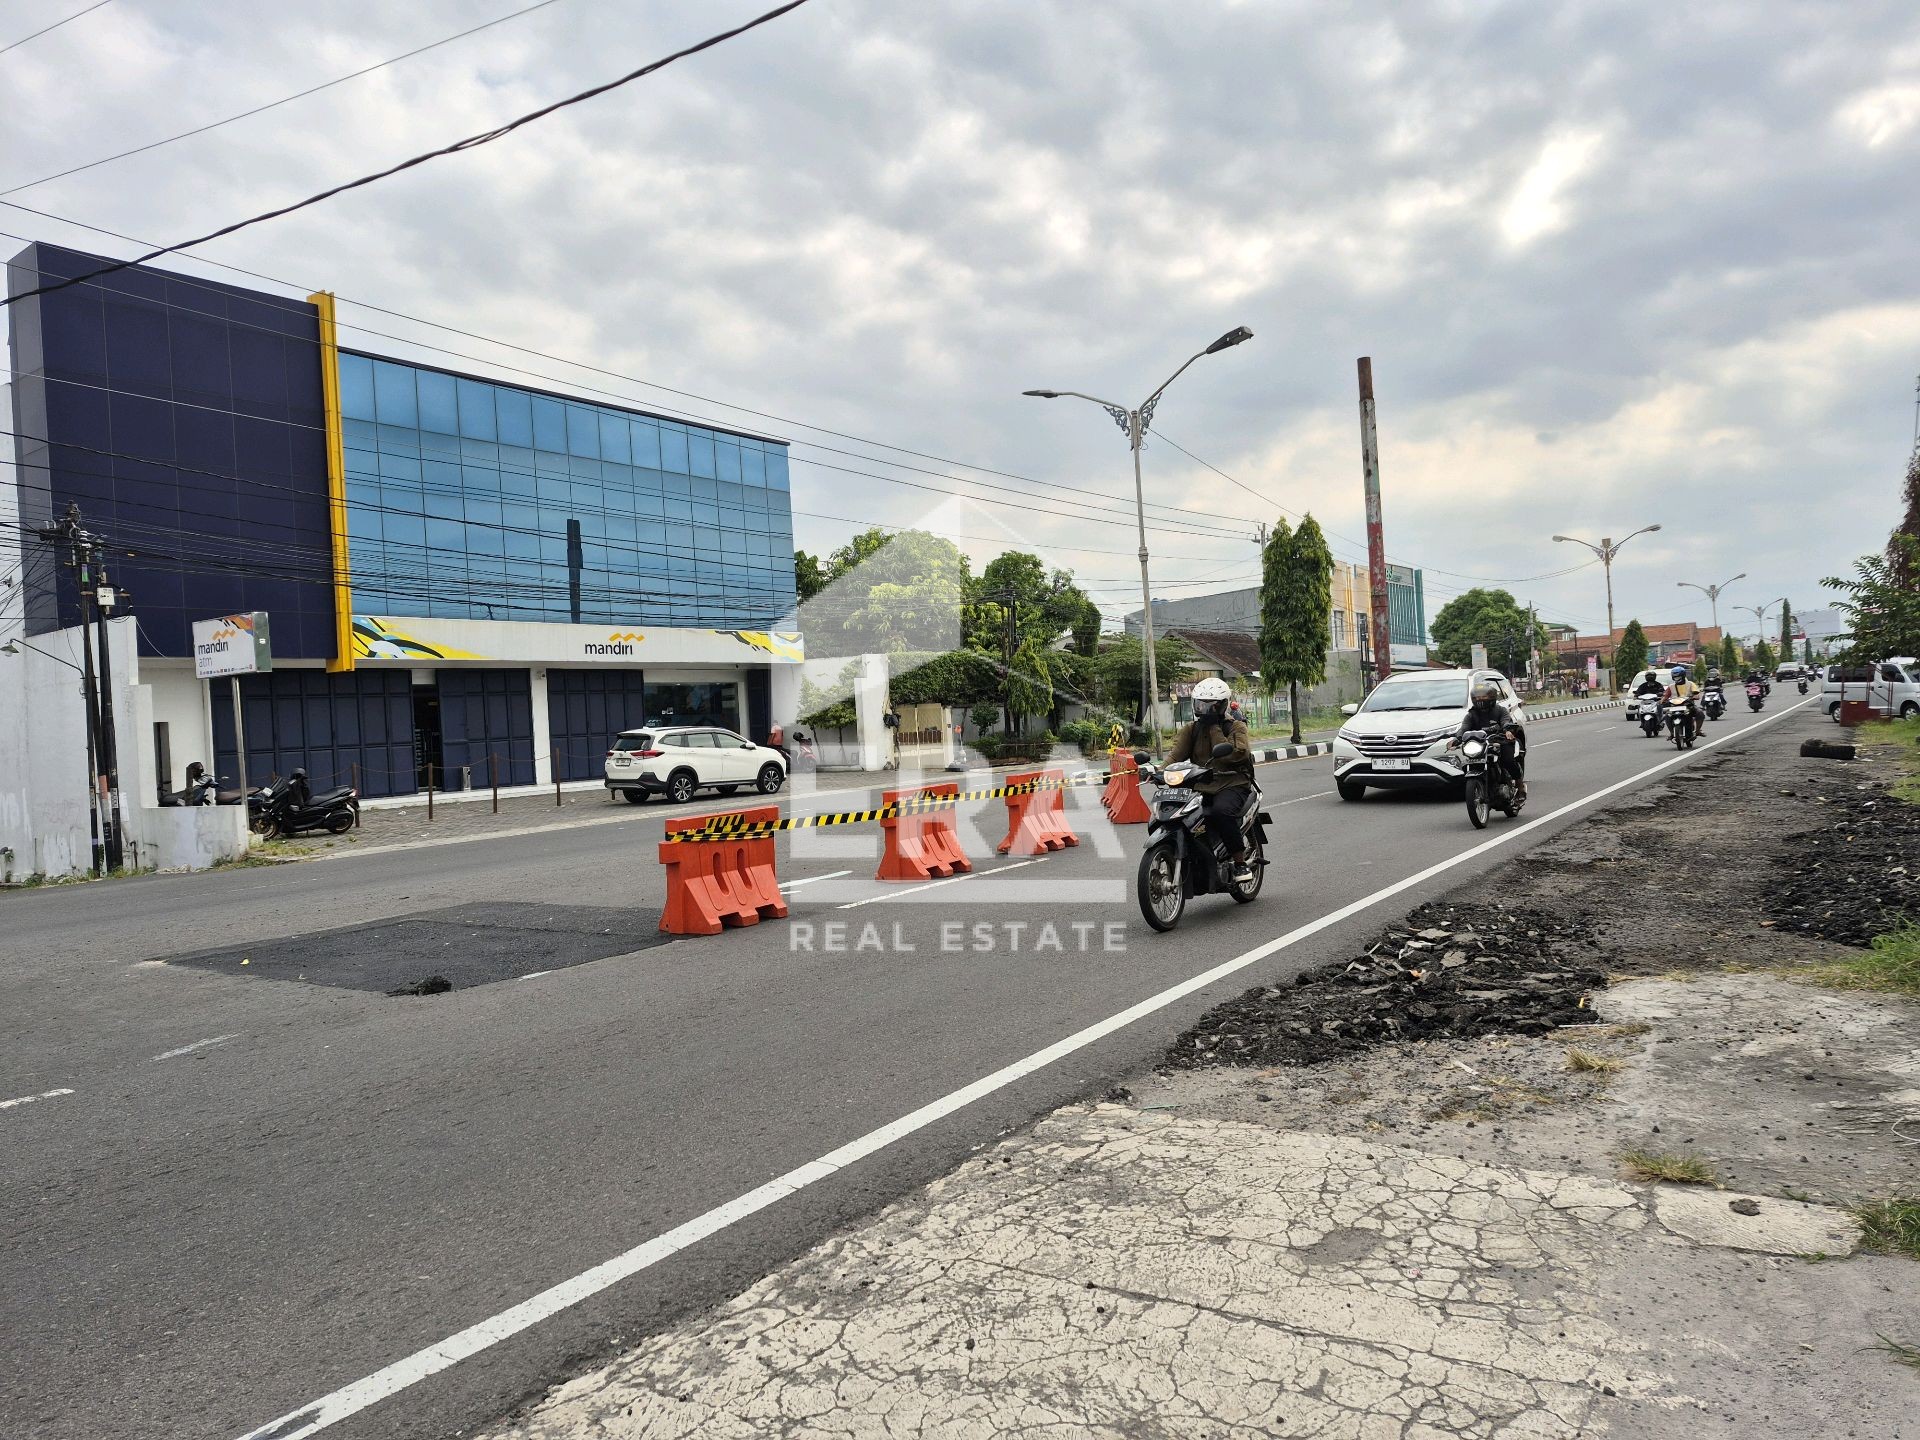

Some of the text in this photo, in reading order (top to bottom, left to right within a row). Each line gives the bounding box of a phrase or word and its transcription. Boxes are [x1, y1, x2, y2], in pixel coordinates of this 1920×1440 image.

[198, 639, 229, 655] mandiri
[584, 640, 633, 655] mandiri
[199, 657, 213, 668] atm
